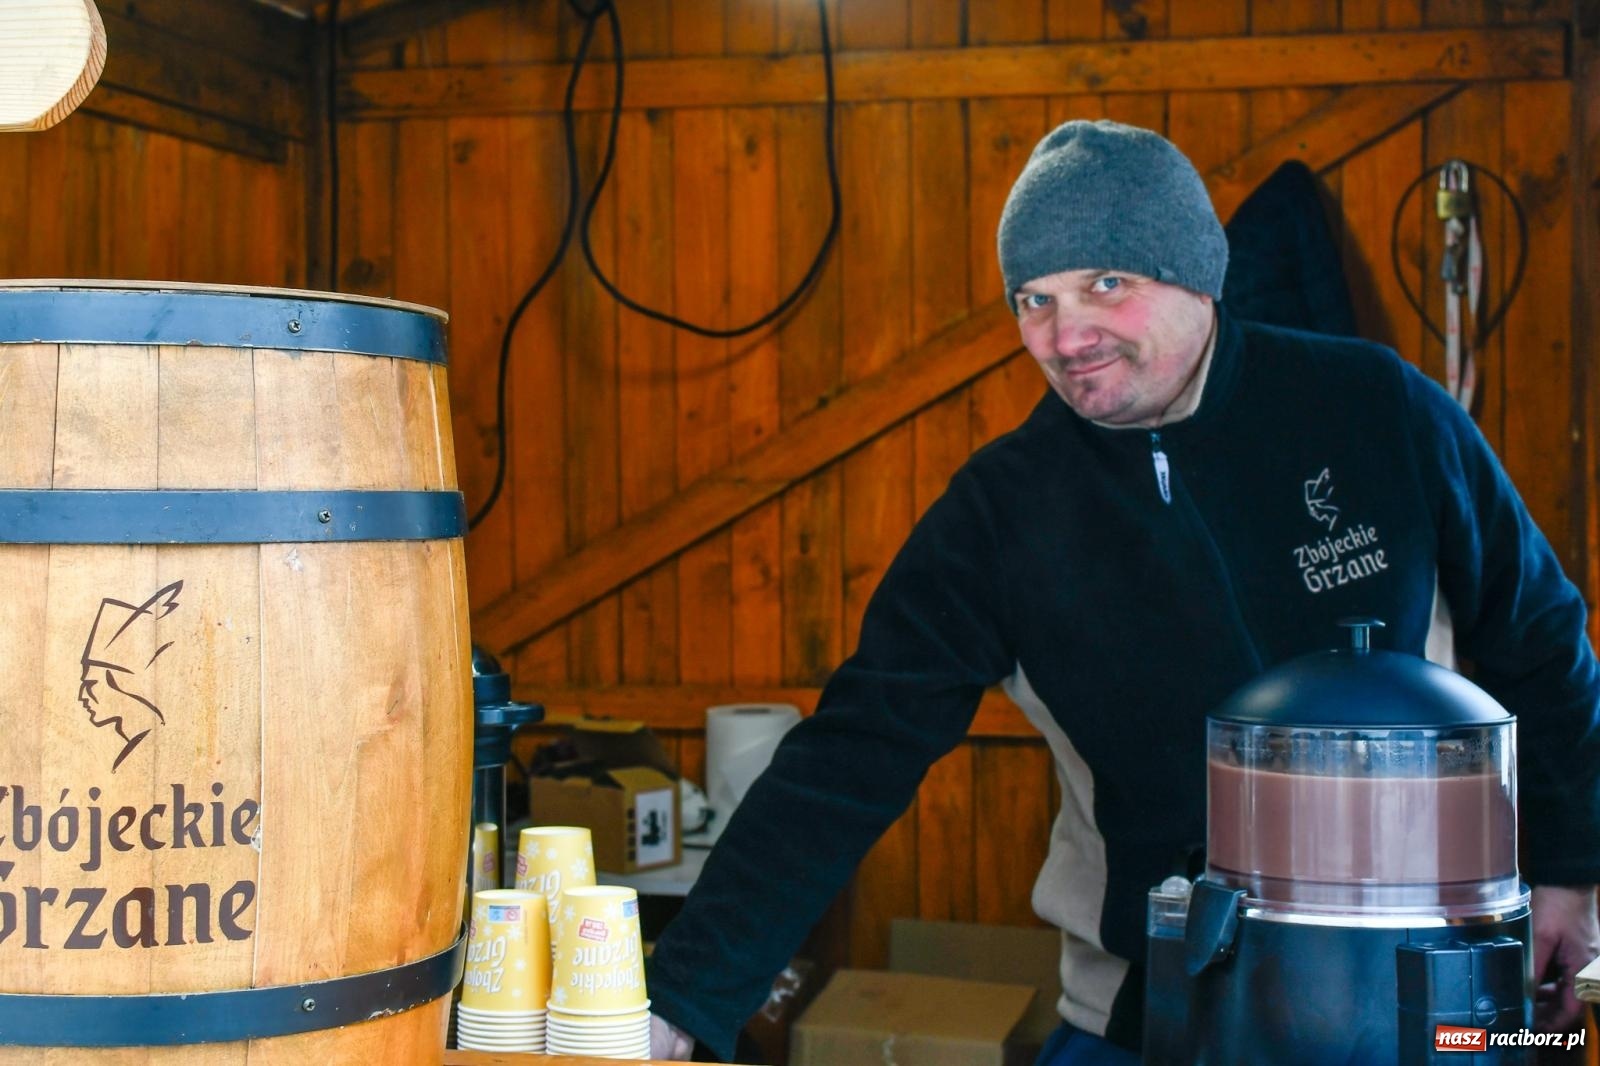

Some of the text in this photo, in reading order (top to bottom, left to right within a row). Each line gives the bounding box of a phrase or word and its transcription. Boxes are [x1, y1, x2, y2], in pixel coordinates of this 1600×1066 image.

[1293, 523, 1378, 568] Zbójeckie
[1303, 549, 1388, 593] Grzane
[0, 782, 259, 872] bójeckie
[572, 931, 639, 967] Grzane
